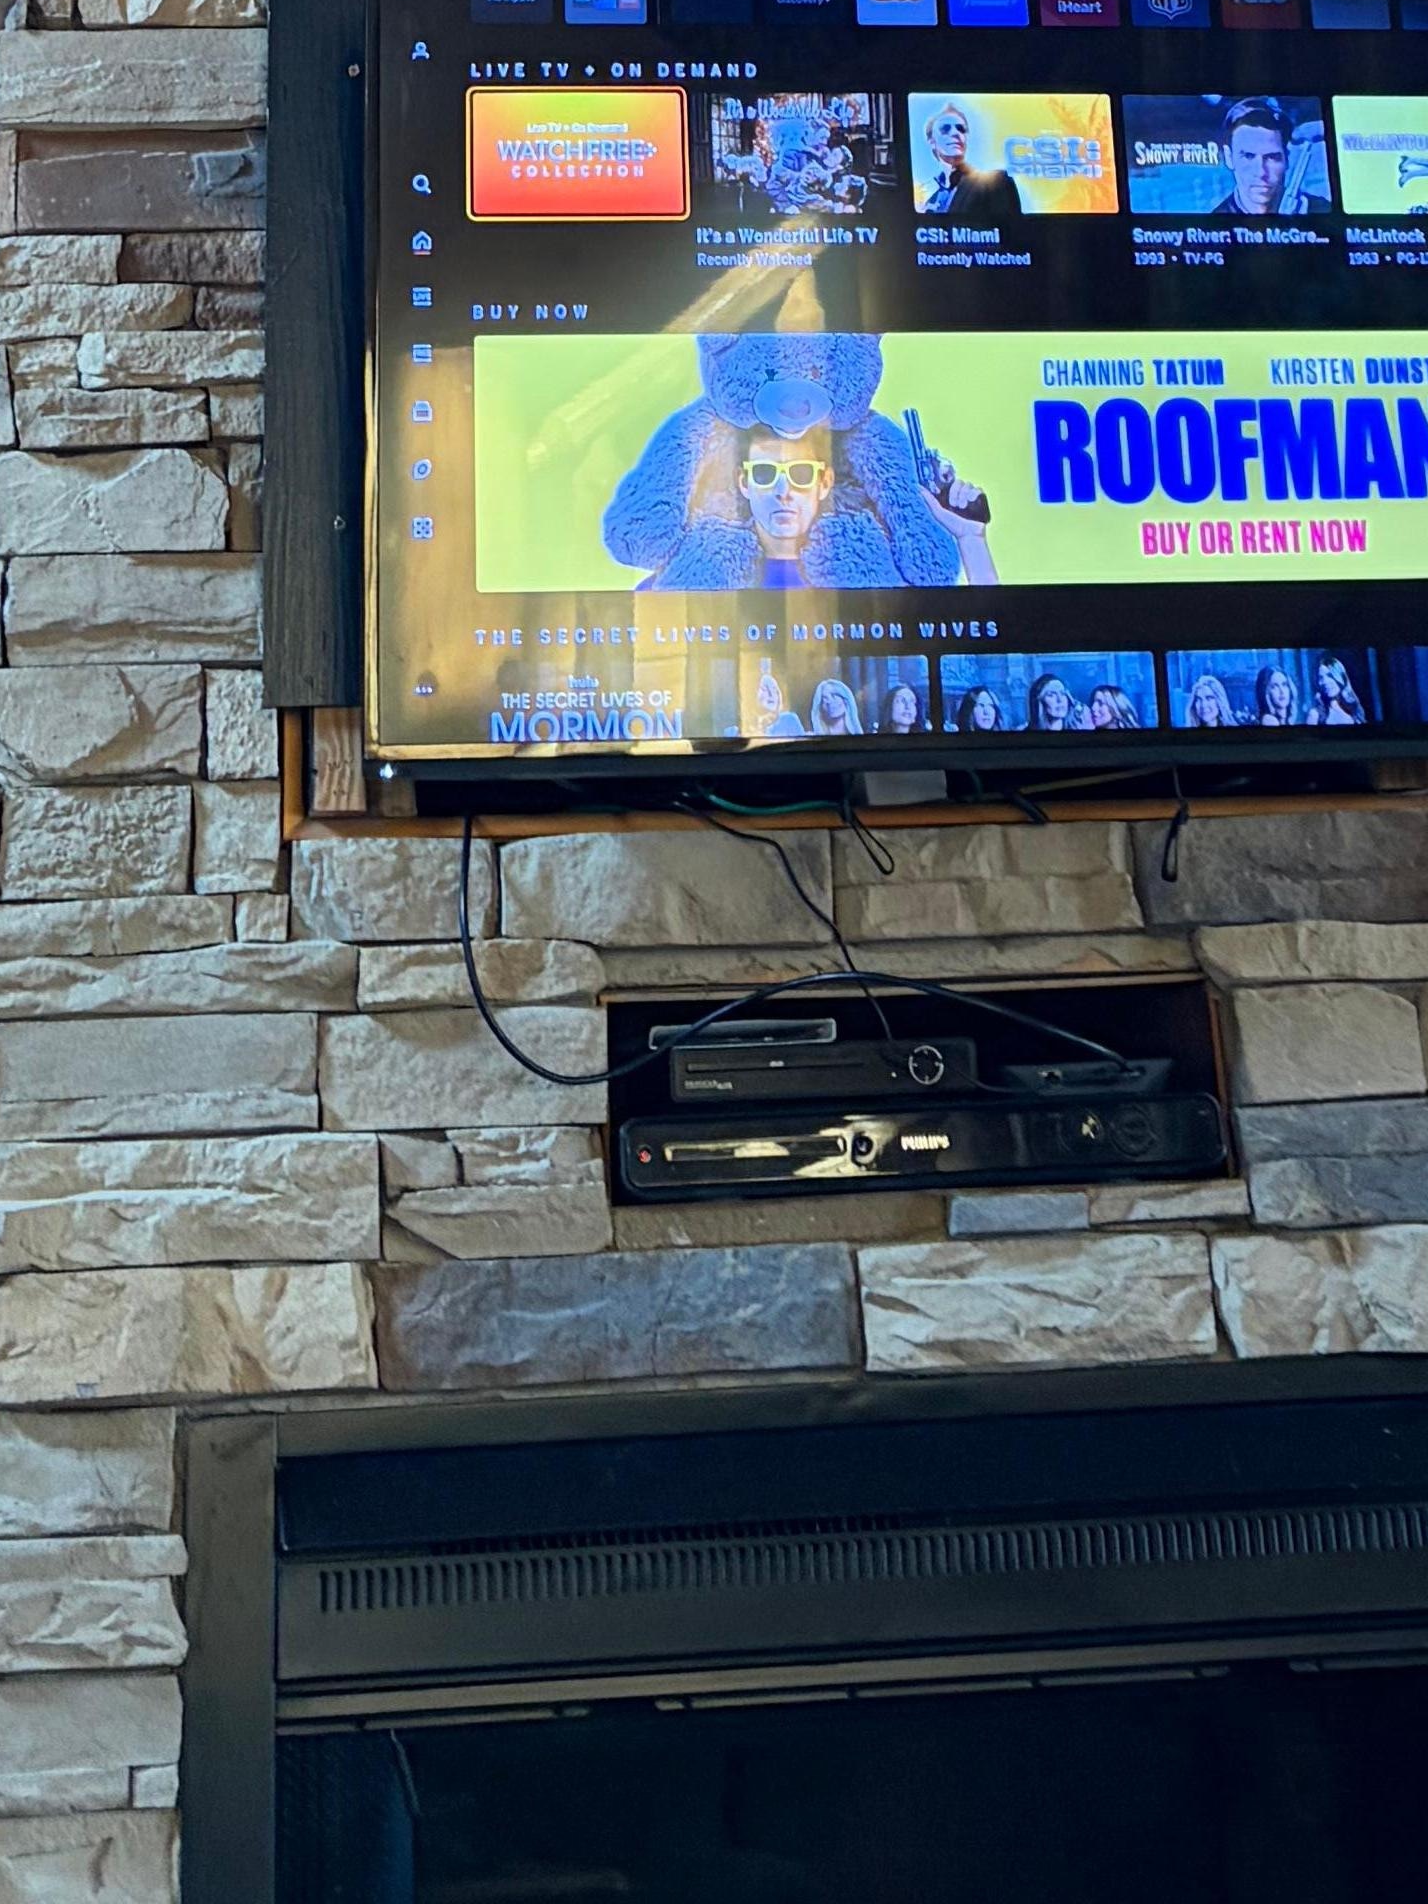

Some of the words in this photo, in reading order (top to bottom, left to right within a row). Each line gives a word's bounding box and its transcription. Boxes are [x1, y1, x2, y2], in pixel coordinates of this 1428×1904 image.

[1058, 0, 1103, 13] iHeart
[470, 62, 525, 78] LIVE
[540, 62, 569, 78] TV
[610, 62, 642, 78] ON
[658, 62, 758, 78] DEMAND
[1134, 141, 1179, 166] SNOWY
[1183, 141, 1219, 166] RIVER
[511, 165, 644, 179] COLLECTION
[696, 228, 722, 244] It's
[725, 232, 736, 244] a
[738, 227, 820, 244] Wonderful
[823, 227, 853, 243] Life
[855, 227, 879, 243] TV
[916, 228, 948, 244] CSI:
[952, 228, 1000, 244] Miami
[1133, 228, 1183, 246] Snowy
[1187, 228, 1231, 244] River:
[1234, 228, 1263, 243] The
[1345, 228, 1426, 244] McLintock
[697, 252, 752, 268] Recently
[756, 252, 812, 267] Watched
[917, 252, 973, 268] Recently
[975, 252, 1031, 266] Watched
[1134, 252, 1165, 265] 1993
[1183, 252, 1224, 265] TV-PG
[472, 304, 519, 320] BUY
[535, 304, 588, 320] NOW
[1043, 359, 1145, 386] CHANNING
[1152, 358, 1224, 385] TATUM
[1271, 358, 1355, 385] KIRSTEN
[1141, 521, 1191, 555] BUY
[1199, 521, 1234, 555] OR
[1240, 520, 1302, 554] RENT
[1309, 519, 1367, 553] NOW
[475, 628, 523, 646] THE
[540, 627, 639, 645] SECRET
[655, 625, 731, 643] LIVES
[747, 624, 777, 640] OF
[793, 623, 903, 640] MORMON
[919, 621, 998, 638] WIVES
[501, 692, 531, 709] THE
[535, 692, 596, 709] SECRET
[601, 691, 644, 708] LIVES
[648, 691, 672, 707] OF
[491, 709, 683, 743] MORMON
